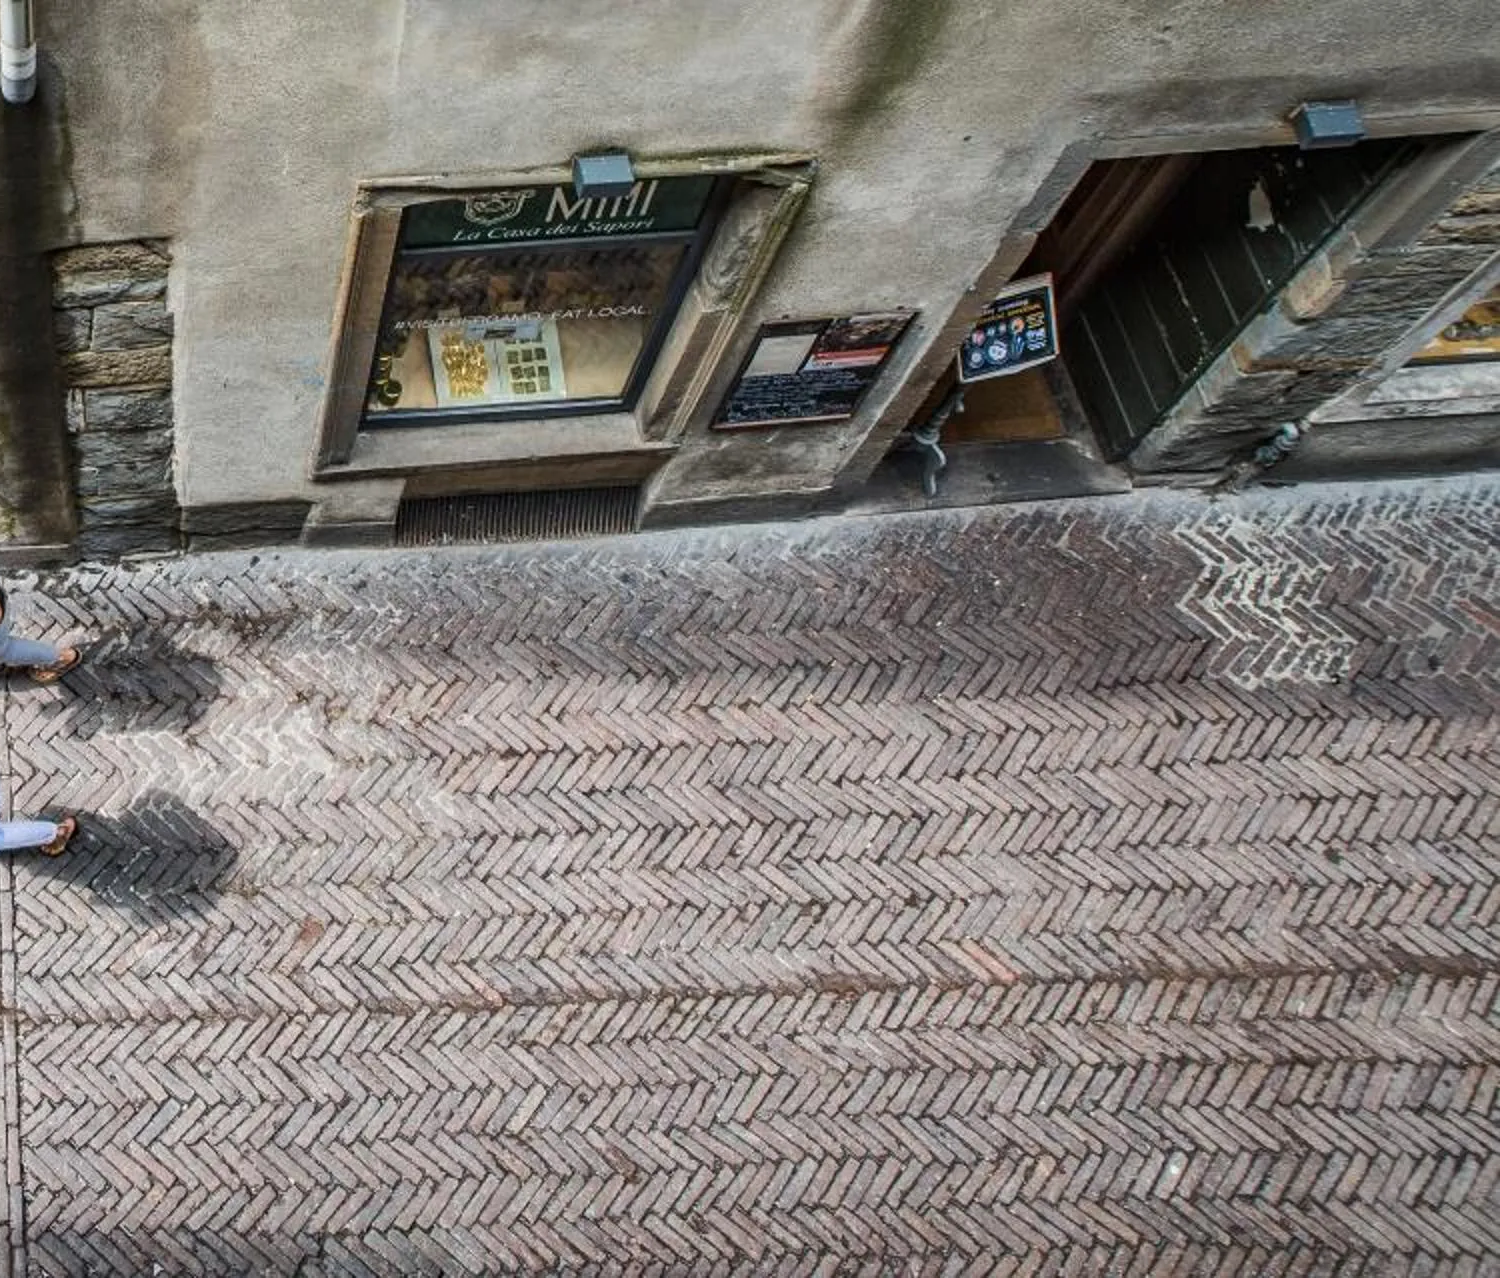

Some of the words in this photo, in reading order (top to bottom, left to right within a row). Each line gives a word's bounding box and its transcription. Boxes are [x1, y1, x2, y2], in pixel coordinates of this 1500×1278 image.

[453, 229, 480, 241] La
[487, 226, 541, 240] Casa
[545, 223, 579, 236] dei
[584, 217, 655, 233] Sapori
